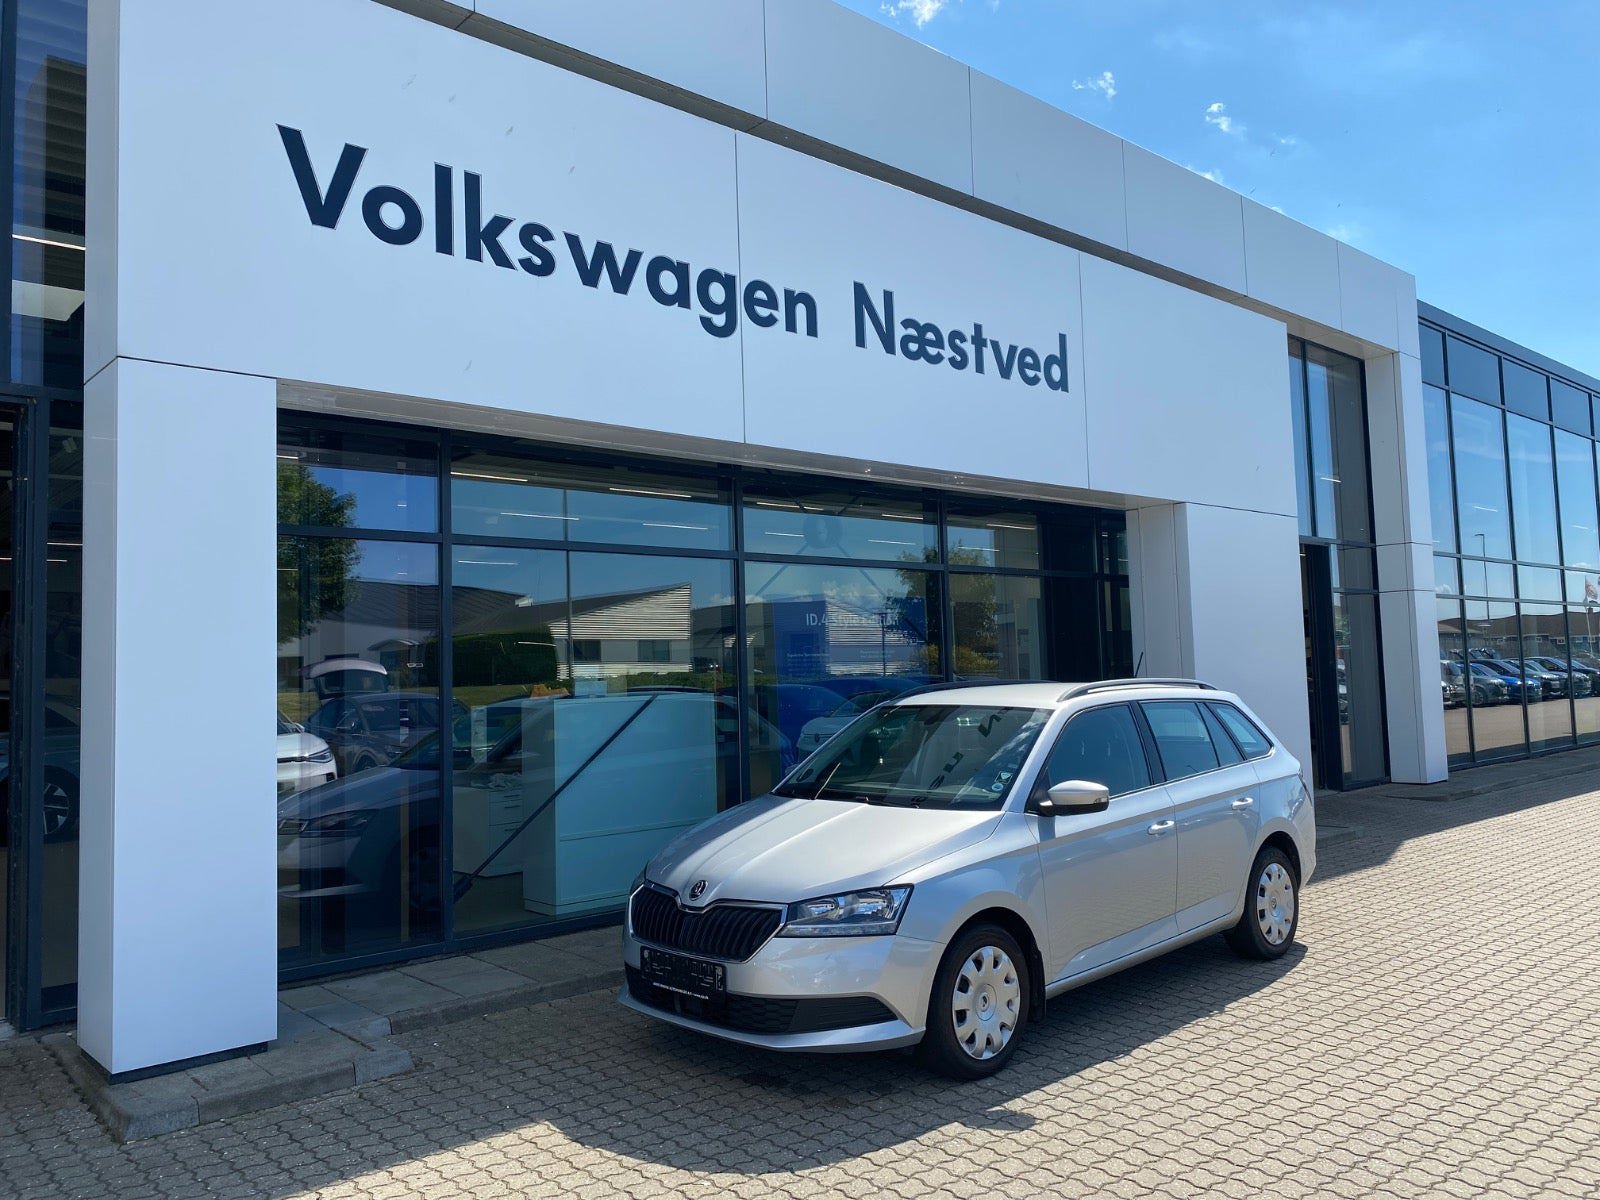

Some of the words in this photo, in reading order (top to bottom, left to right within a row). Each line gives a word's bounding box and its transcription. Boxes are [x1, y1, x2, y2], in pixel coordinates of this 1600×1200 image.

[275, 123, 819, 338] Volkswagen
[853, 280, 1069, 393] Næstved
[806, 613, 828, 627] ID.4
